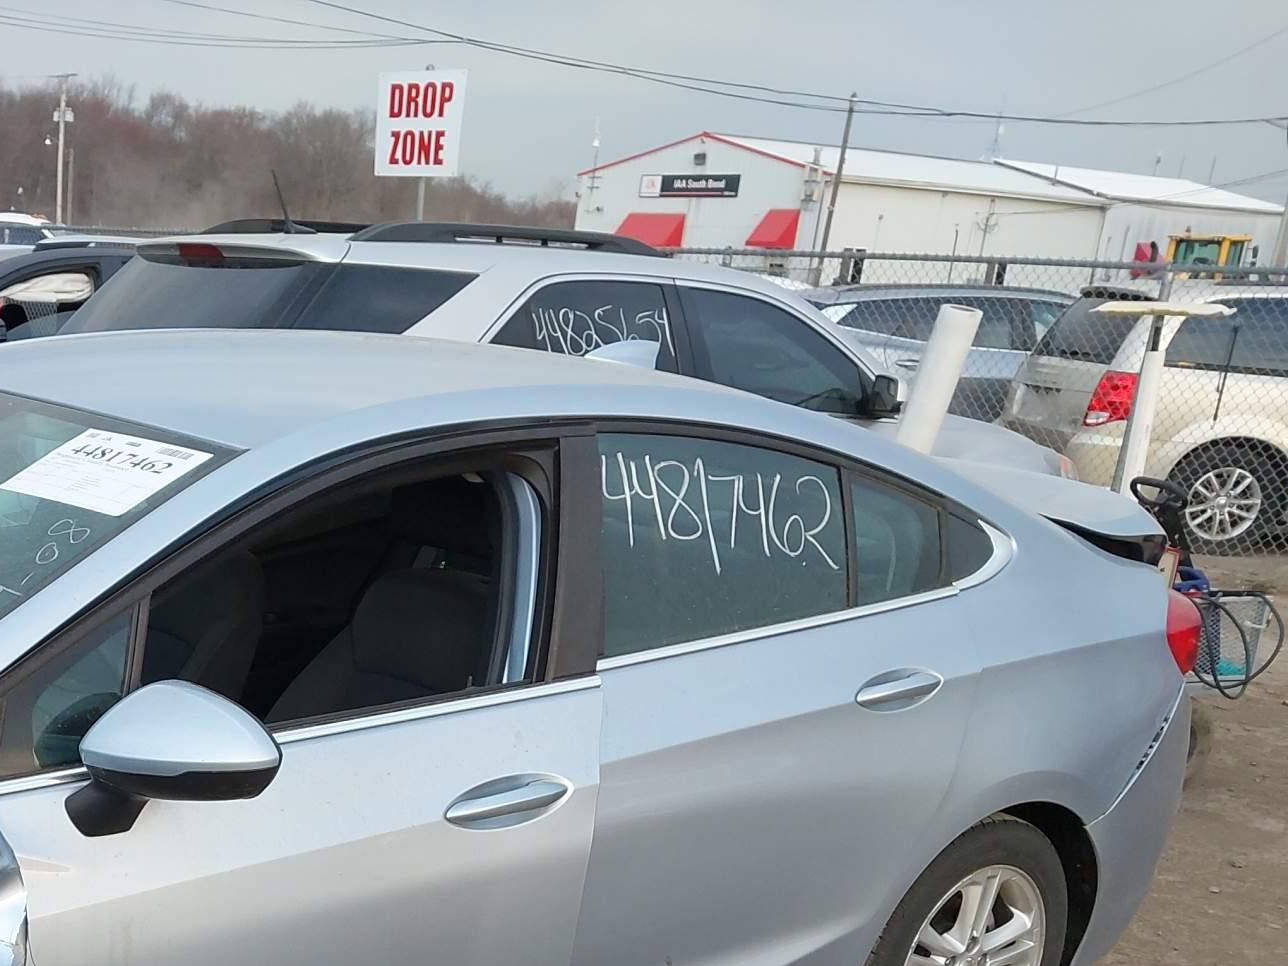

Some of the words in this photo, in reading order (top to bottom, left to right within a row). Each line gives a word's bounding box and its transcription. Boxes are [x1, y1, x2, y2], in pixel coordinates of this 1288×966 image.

[388, 81, 454, 118] DROP
[388, 129, 446, 166] ZONE
[71, 443, 174, 475] 44817462
[601, 451, 840, 576] 44817462
